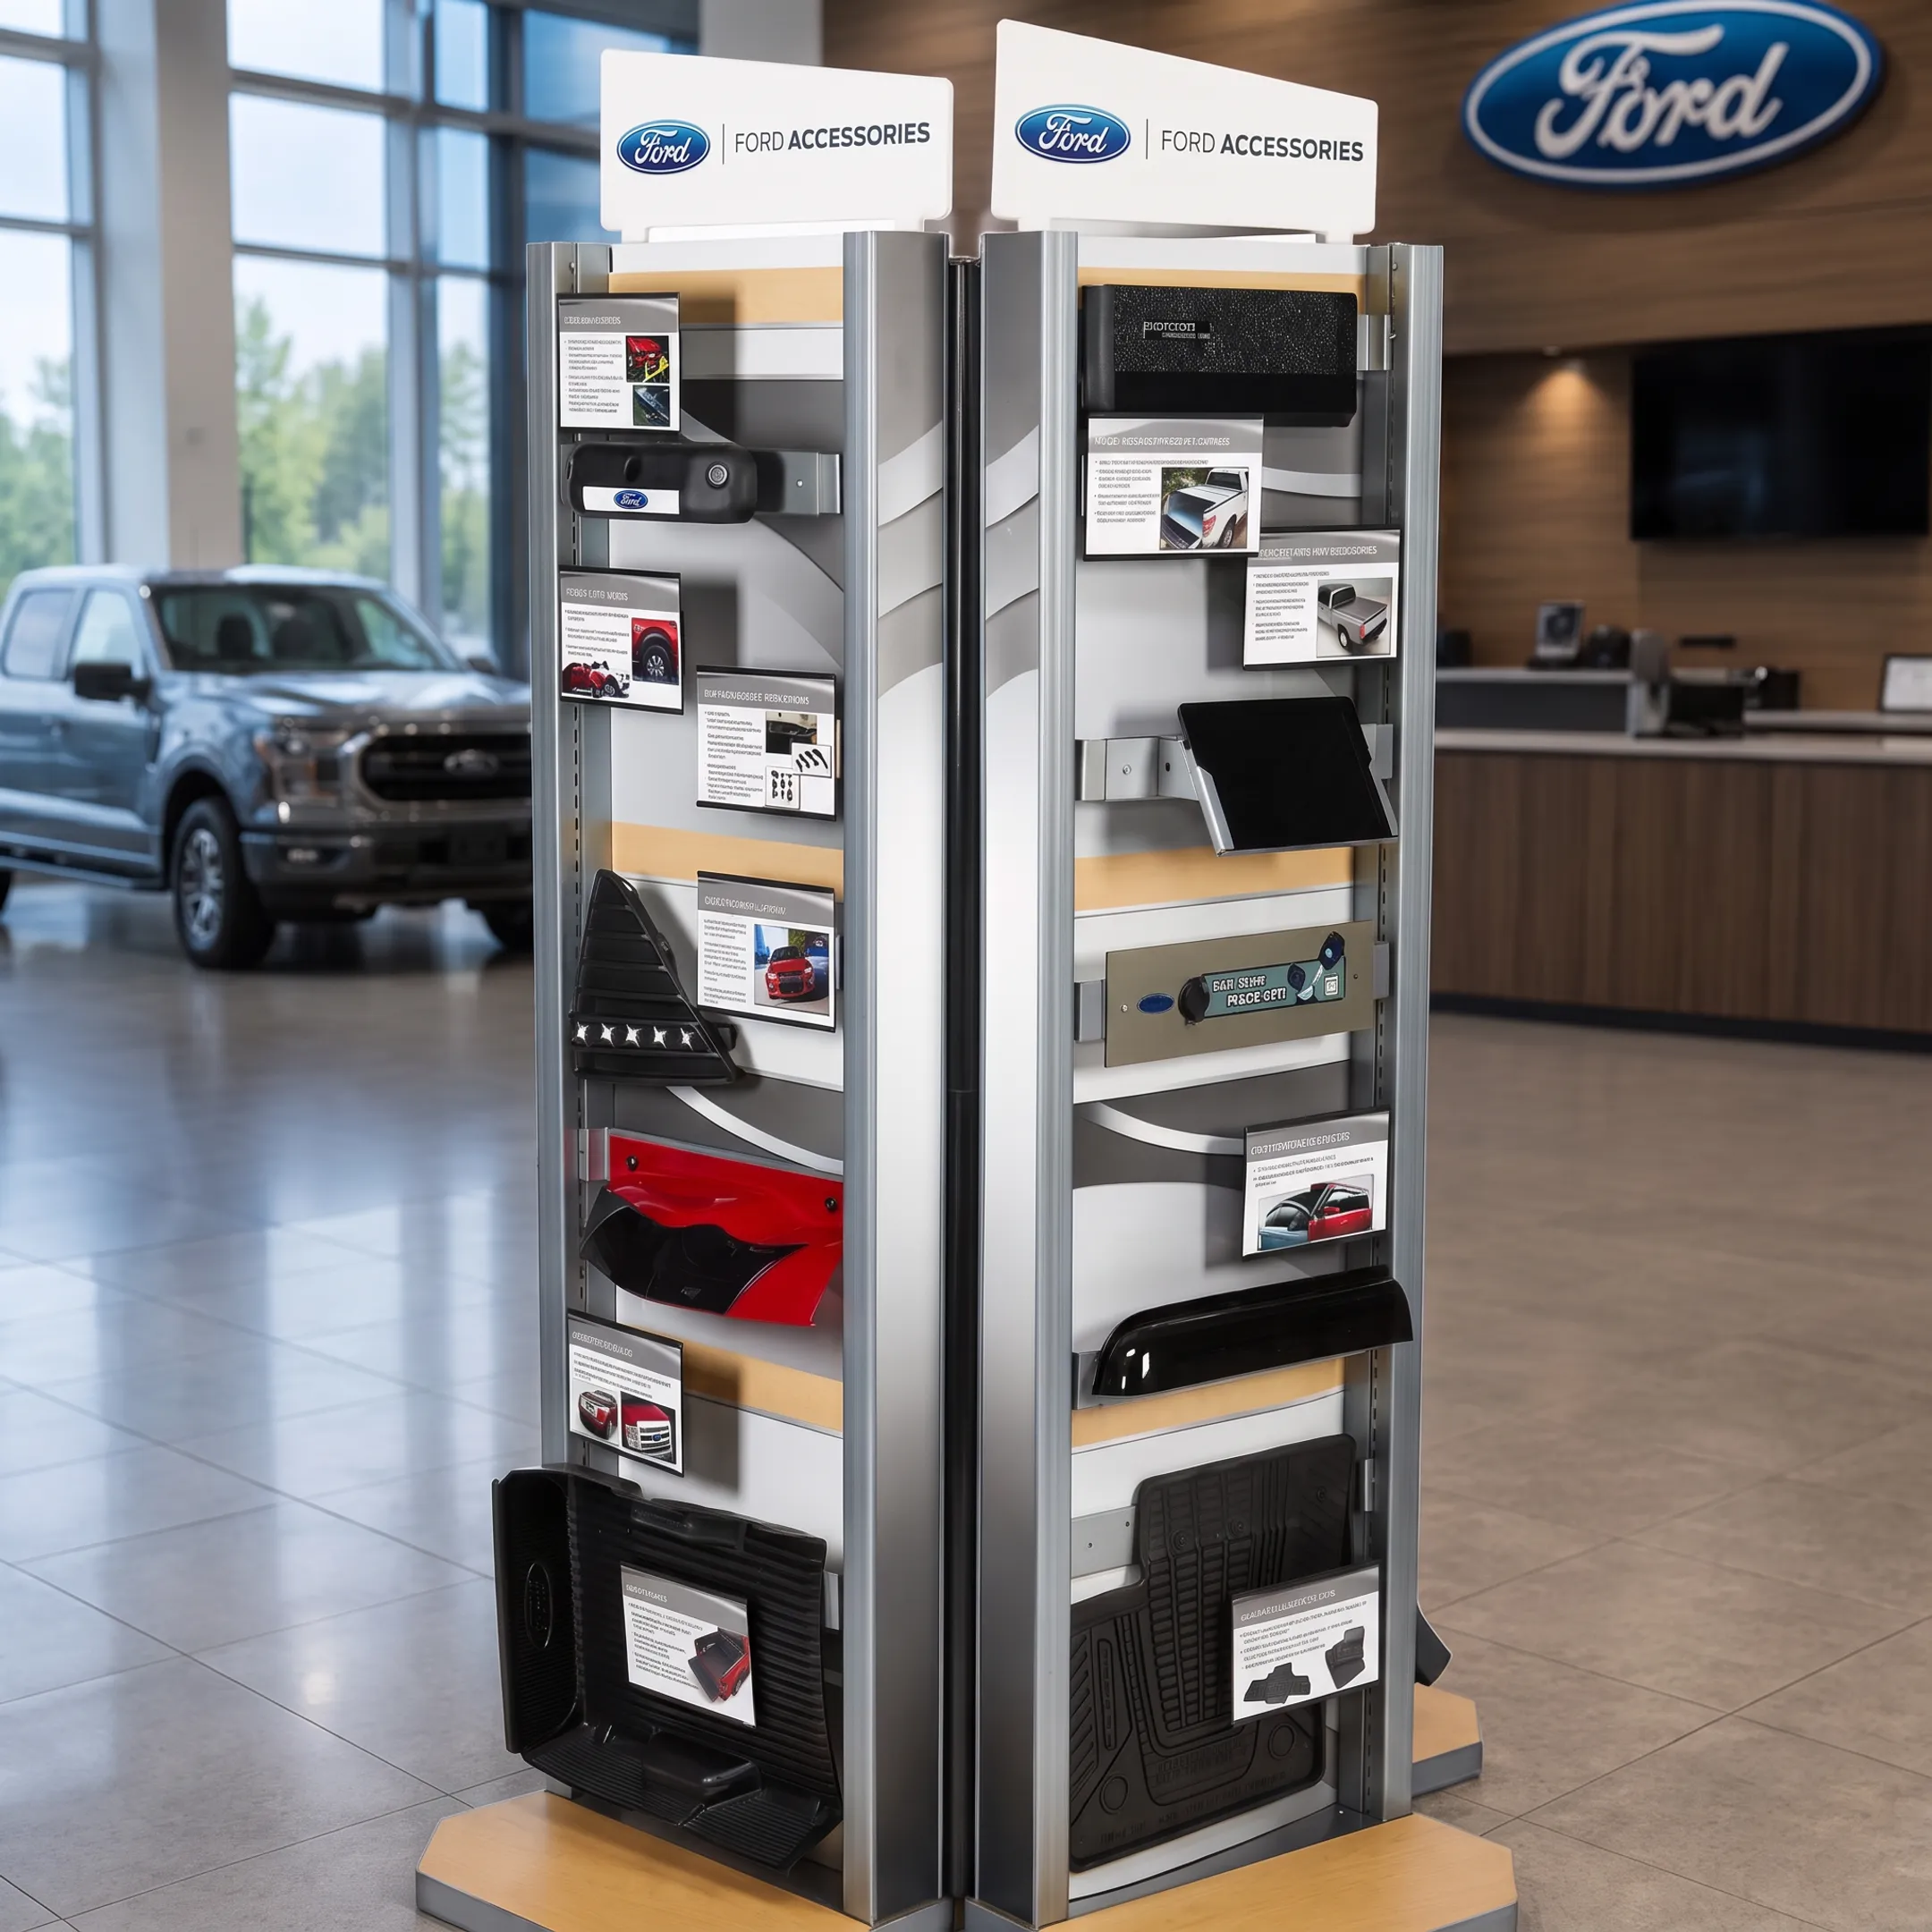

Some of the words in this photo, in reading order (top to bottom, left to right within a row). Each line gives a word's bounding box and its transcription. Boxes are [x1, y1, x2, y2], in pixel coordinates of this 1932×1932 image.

[1534, 22, 1789, 159] Ford
[633, 129, 691, 165] Ford
[734, 131, 784, 153] FORD
[787, 122, 931, 150] ACCESSORIES
[1038, 113, 1110, 153] Ford
[1161, 130, 1216, 153] FORD
[1220, 133, 1364, 162] ACCESSORIES
